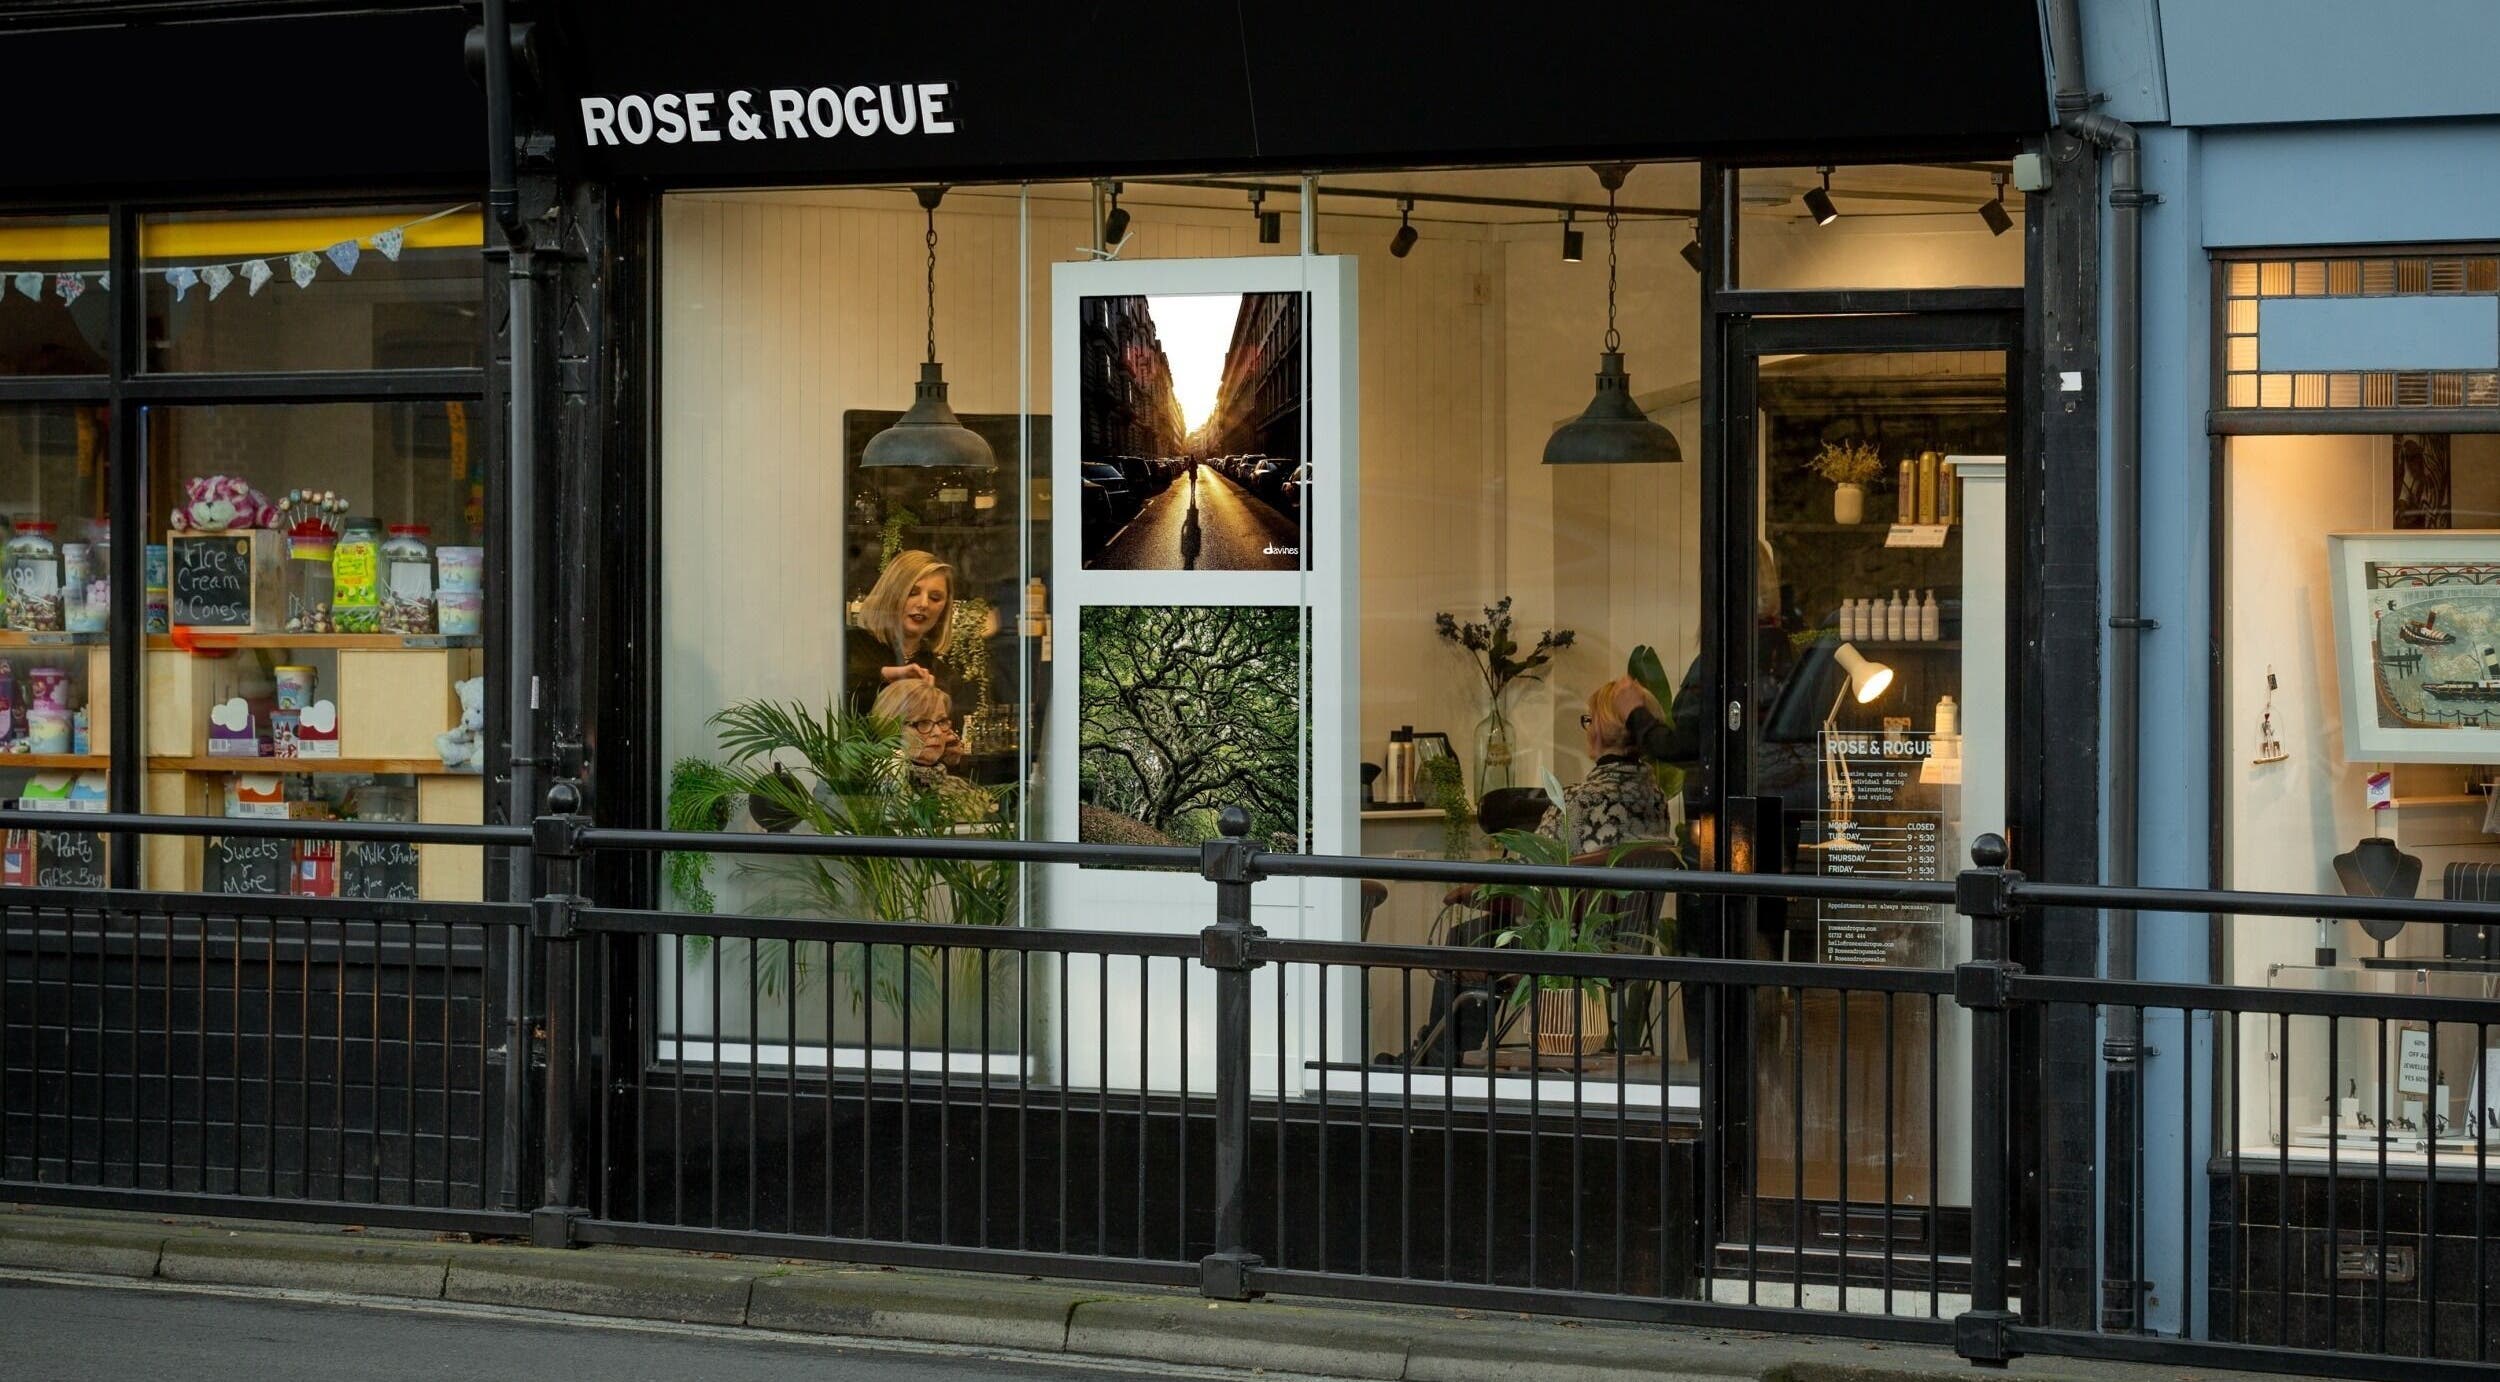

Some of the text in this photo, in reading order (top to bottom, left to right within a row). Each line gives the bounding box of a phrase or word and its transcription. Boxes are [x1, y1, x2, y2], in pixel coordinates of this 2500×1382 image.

[580, 83, 955, 146] ROSE & ROGUE
[191, 542, 227, 572] Ice
[1262, 541, 1299, 555] davines
[178, 567, 241, 592] Cream
[189, 595, 241, 622] Cones
[1827, 740, 1933, 755] ROSE & ROGUE
[1828, 821, 1936, 831] MONDAY CLOSED
[1828, 832, 1861, 840] TUESDAY
[57, 830, 93, 864] Party
[222, 836, 279, 864] Sweets
[360, 842, 387, 867] Milk
[1828, 844, 1872, 852] WEDNESDAY
[1907, 845, 1912, 853] 9
[1919, 845, 1935, 853] 5:30
[1828, 854, 1866, 862] THURSDAY
[1907, 855, 1912, 863] 9
[1919, 855, 1935, 863] 5:30
[1828, 865, 1854, 873] FRIDAY
[1907, 866, 1912, 874] 9
[1919, 866, 1935, 874] 5:30
[223, 875, 276, 895] More
